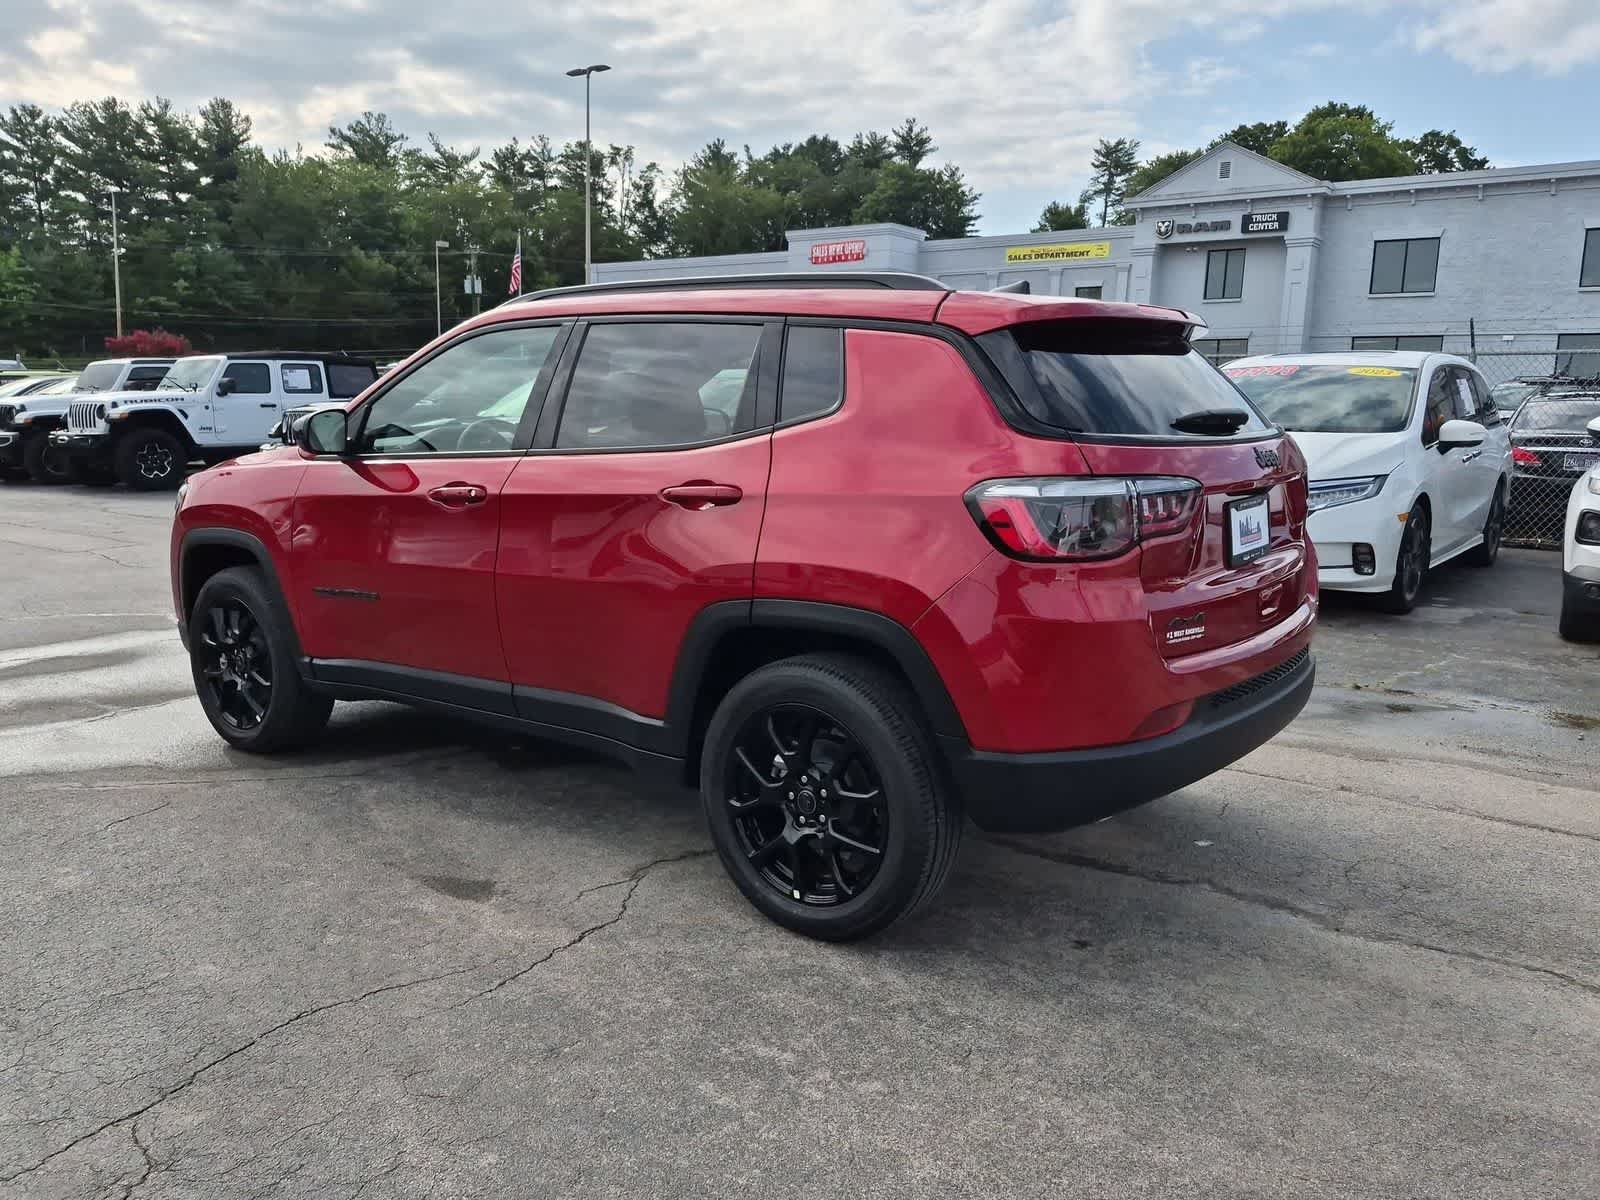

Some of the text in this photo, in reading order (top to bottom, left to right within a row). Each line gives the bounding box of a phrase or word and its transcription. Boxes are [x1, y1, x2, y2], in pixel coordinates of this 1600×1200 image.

[1251, 213, 1278, 222] TRUCK
[1248, 221, 1279, 231] CENTER
[1007, 253, 1033, 262] SALES
[1034, 250, 1091, 260] DEPARTMENT
[123, 397, 185, 405] RUBICON
[1252, 446, 1281, 471] Jeep
